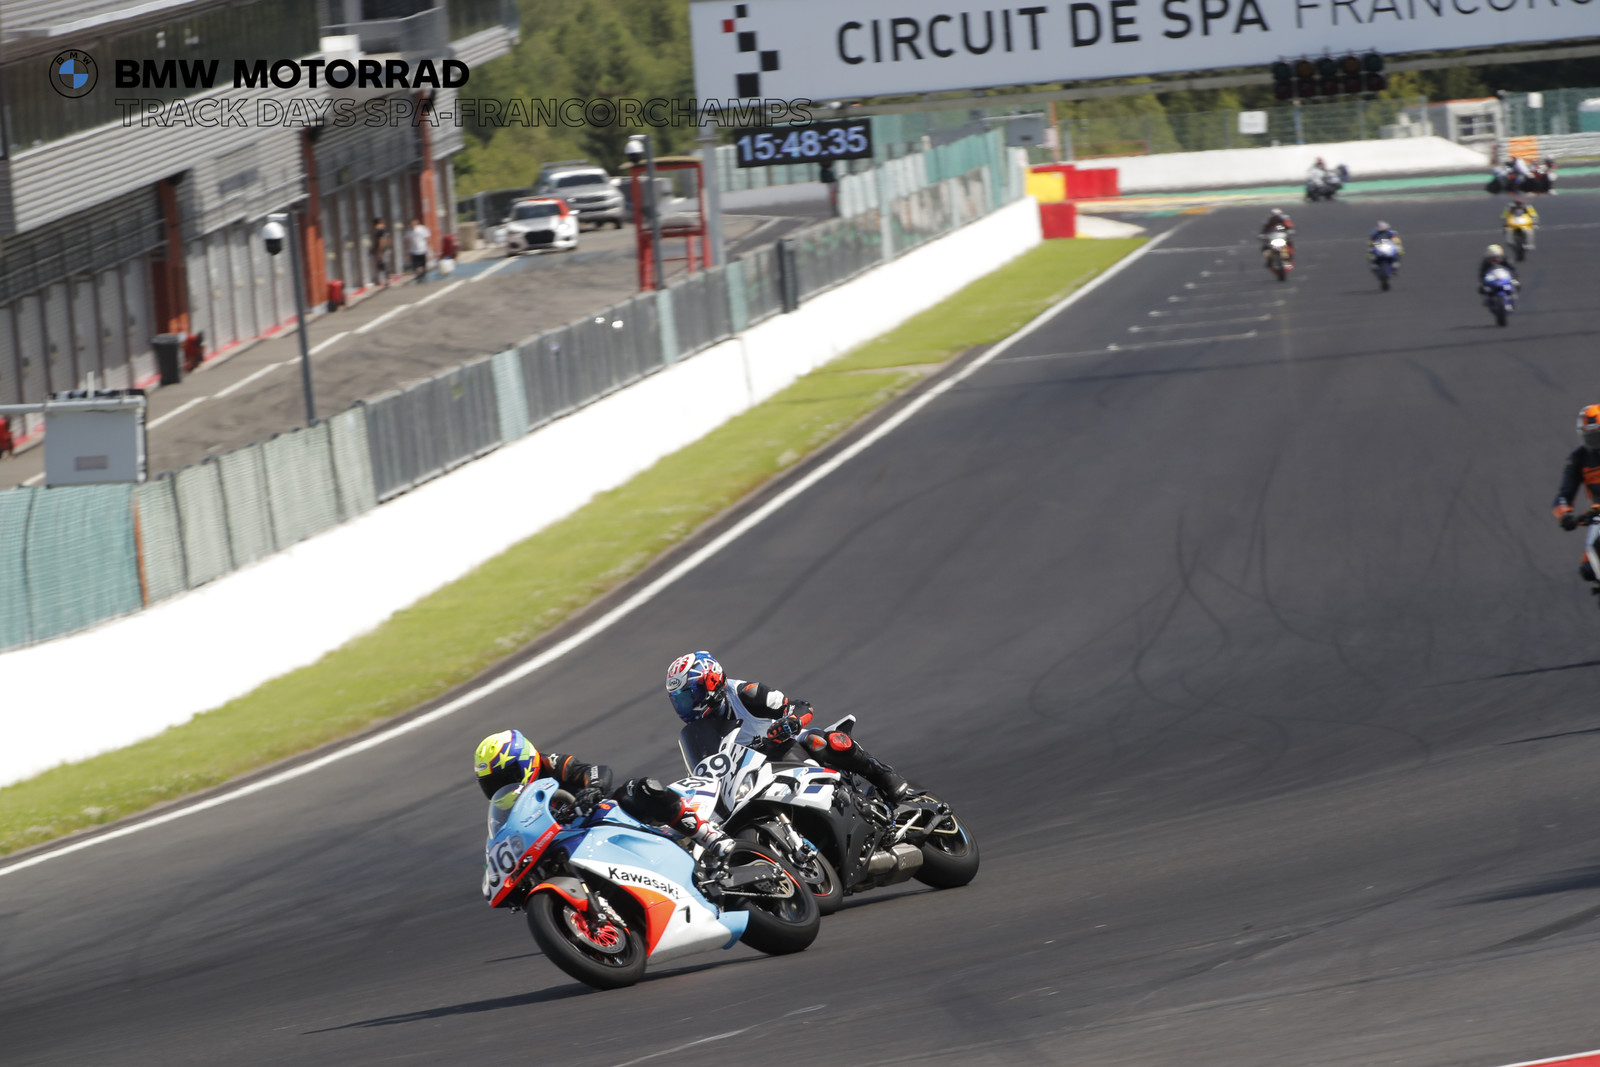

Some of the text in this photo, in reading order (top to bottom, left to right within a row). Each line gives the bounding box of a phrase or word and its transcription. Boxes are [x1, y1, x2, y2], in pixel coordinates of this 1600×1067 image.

[836, 6, 1048, 65] CIRCUIT
[1070, 1, 1139, 48] DE
[1162, 0, 1269, 39] SPA
[737, 126, 868, 161] 15:48:35
[608, 867, 679, 899] Kawasaki
